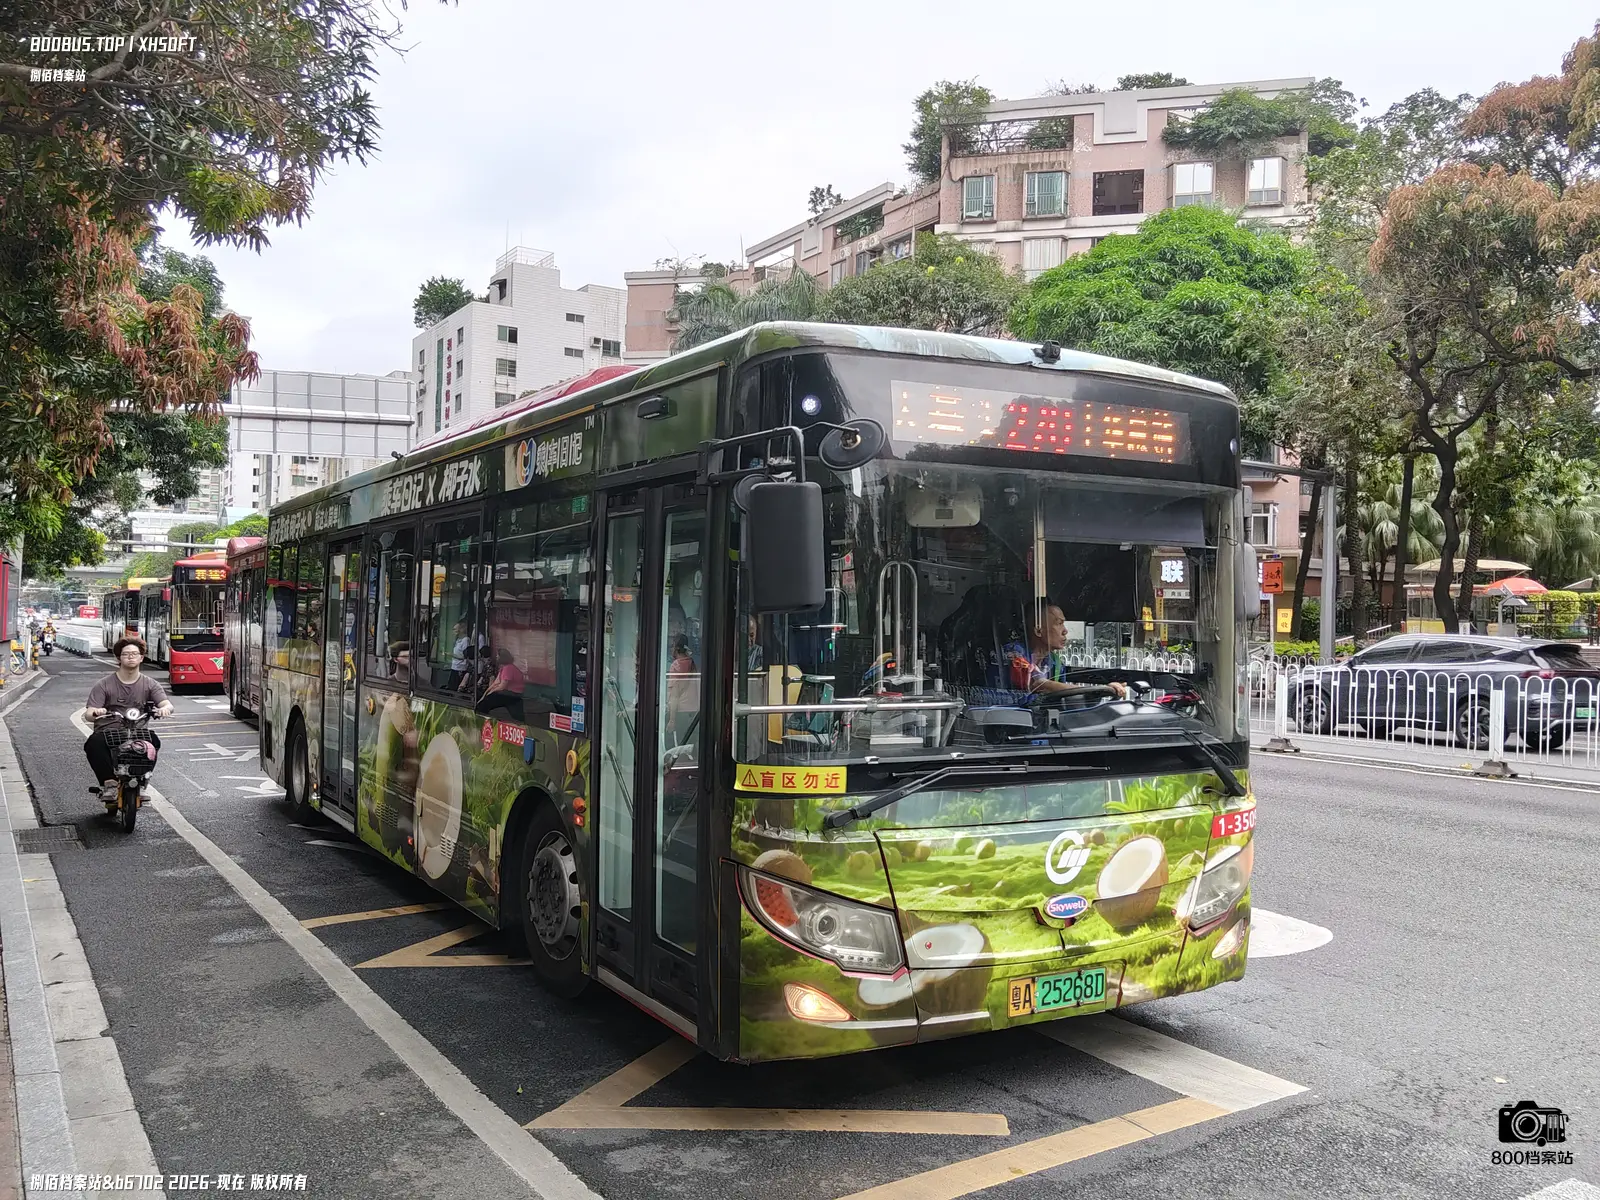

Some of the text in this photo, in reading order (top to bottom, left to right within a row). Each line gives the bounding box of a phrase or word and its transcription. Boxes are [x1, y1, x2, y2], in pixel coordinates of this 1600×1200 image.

[380, 472, 424, 517] 乘车日记
[438, 455, 482, 503] 椰子水
[1160, 560, 1184, 583] 联
[499, 723, 525, 746] 1-35095
[760, 770, 841, 789] 盲区勿近
[1050, 900, 1086, 913] Skywell
[1011, 972, 1105, 1011] 粤A 25268D
